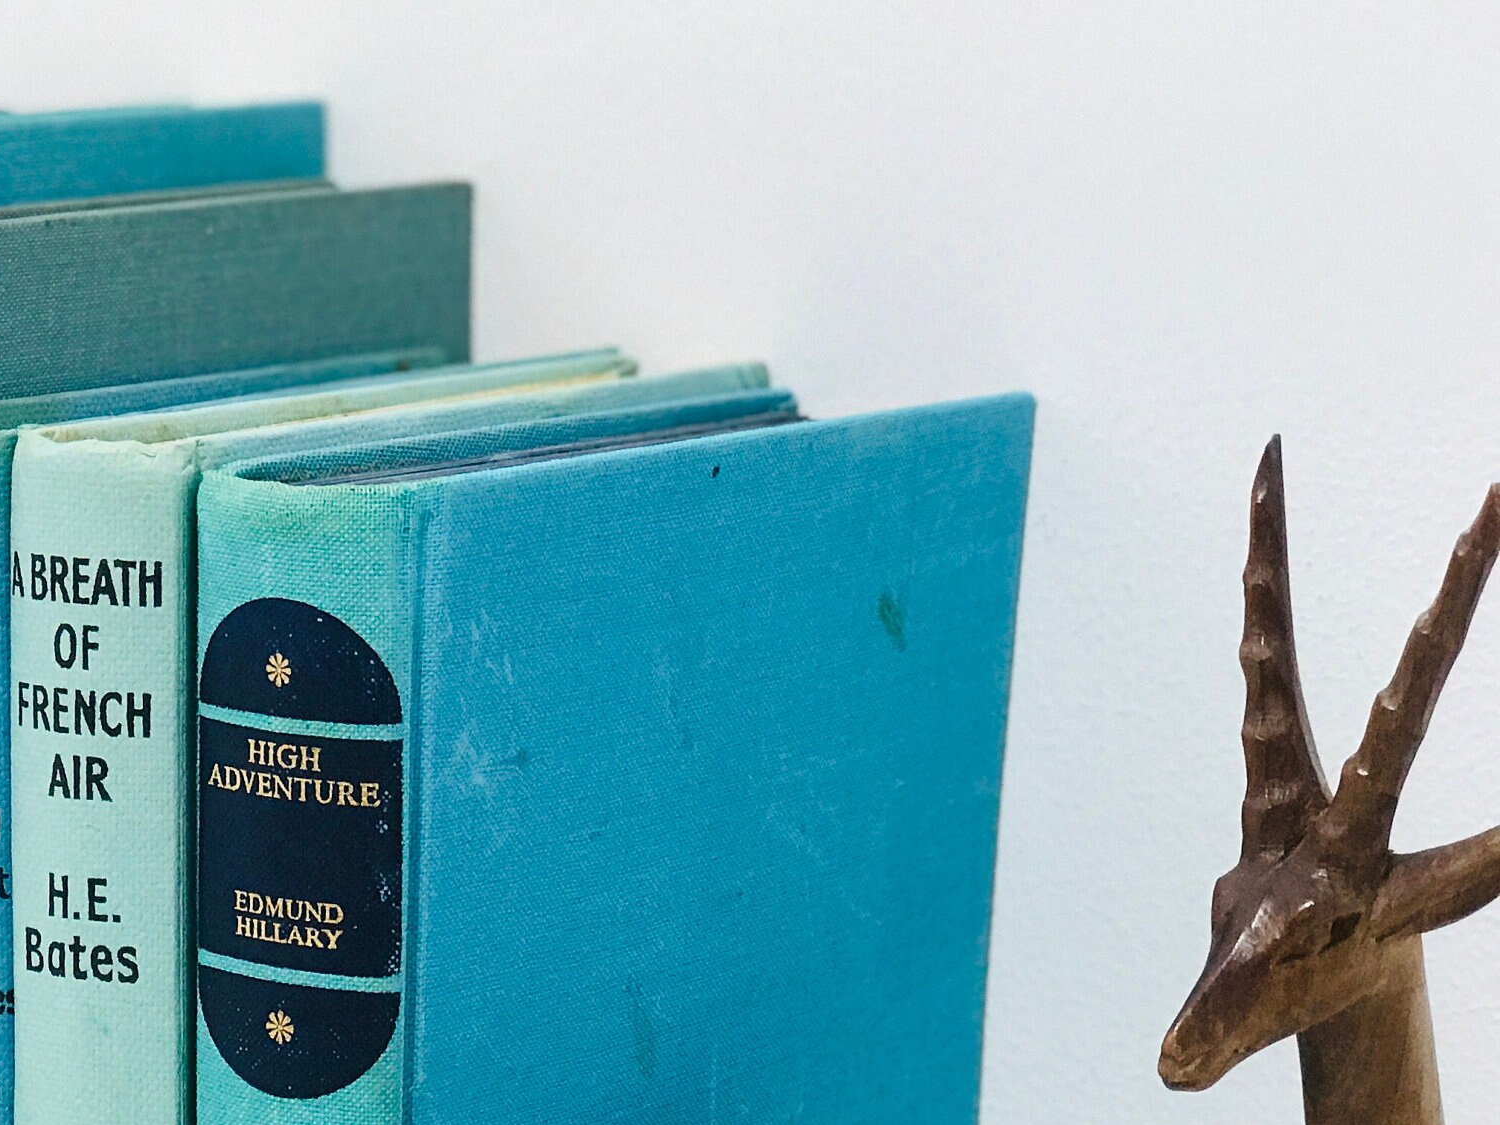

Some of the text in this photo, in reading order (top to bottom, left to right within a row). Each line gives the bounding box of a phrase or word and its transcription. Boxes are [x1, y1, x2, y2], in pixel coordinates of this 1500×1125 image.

[12, 550, 163, 608] A BREATH
[54, 623, 99, 671] OF
[18, 681, 152, 738] FRENCH
[48, 754, 113, 802] AIR
[247, 739, 322, 773] HIGH
[207, 765, 381, 808] ADVENTURE
[48, 872, 121, 923] H.E.
[233, 890, 345, 924] EDMUND
[25, 926, 139, 985] Bates
[235, 915, 344, 950] HILLARY
